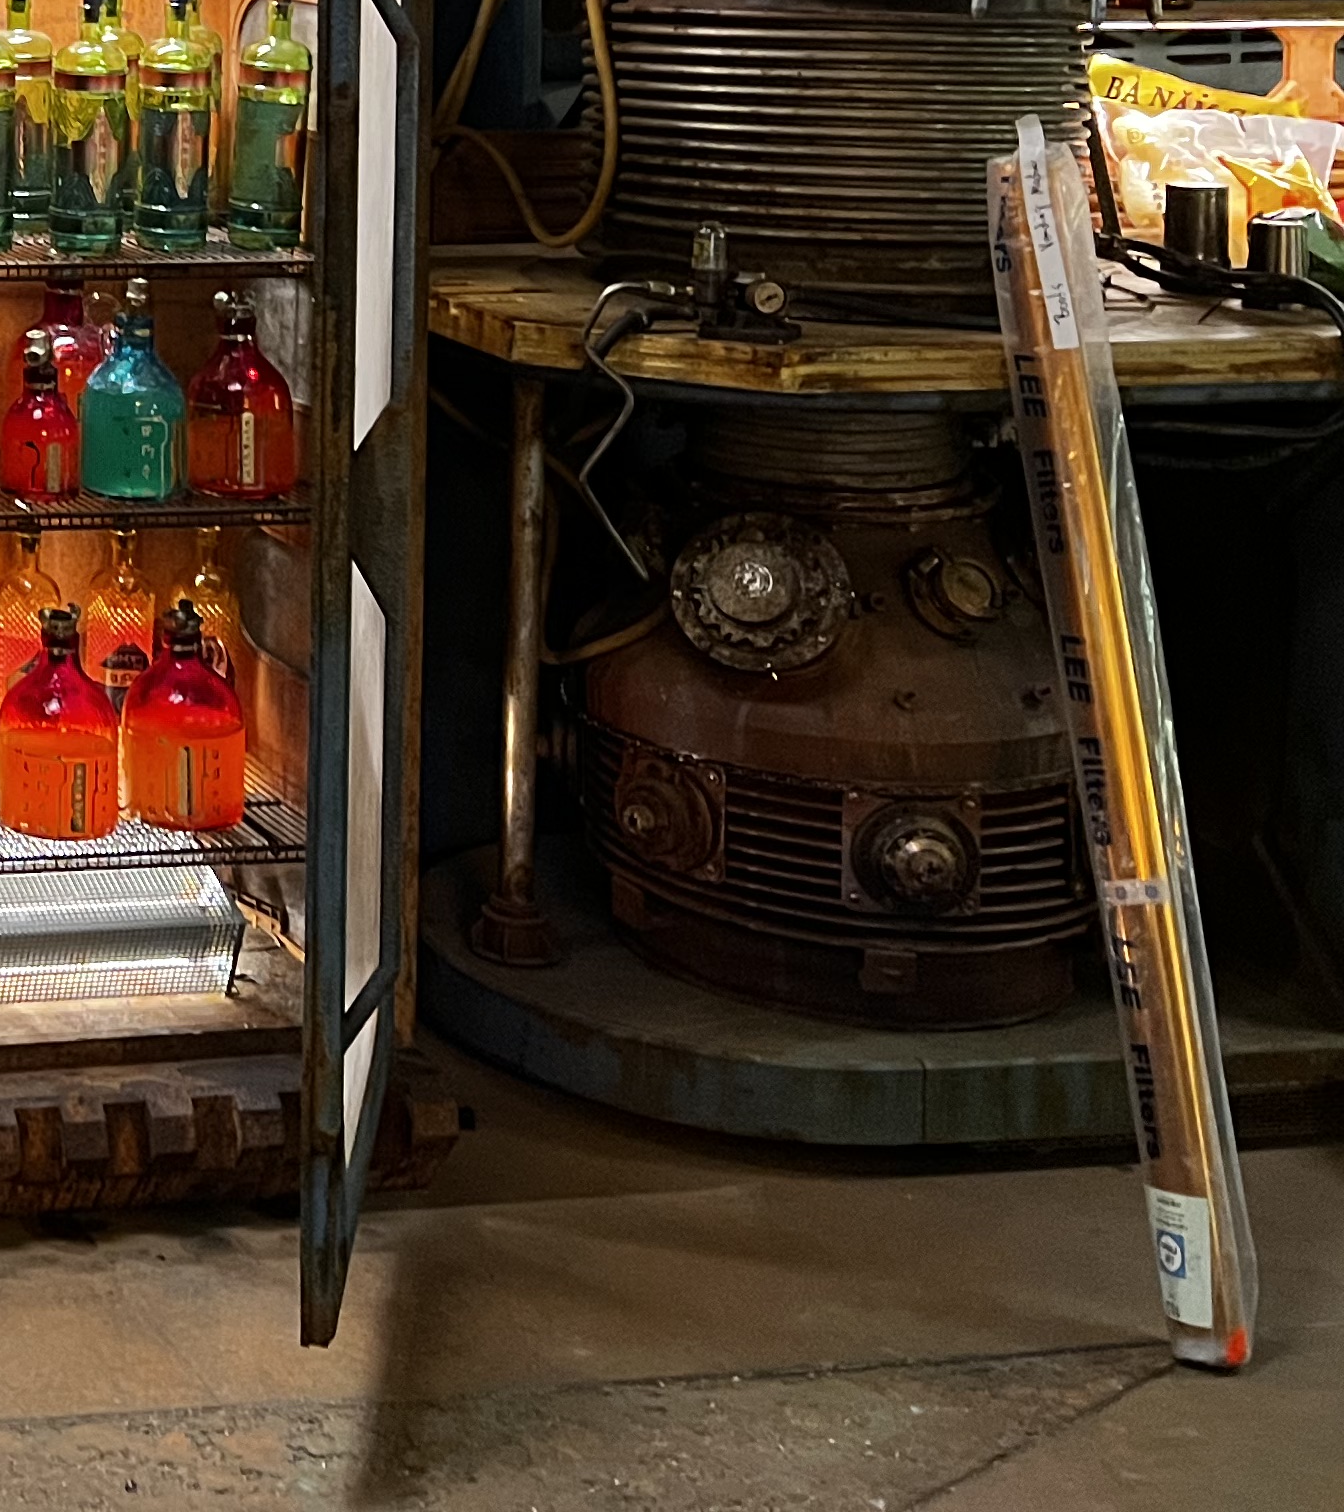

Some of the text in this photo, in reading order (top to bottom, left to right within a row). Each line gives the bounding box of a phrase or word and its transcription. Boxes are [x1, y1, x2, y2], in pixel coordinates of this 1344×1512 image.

[1014, 354, 1065, 555] LEE Filters
[1060, 634, 1092, 704] LEE
[1131, 1043, 1161, 1160] Filters
